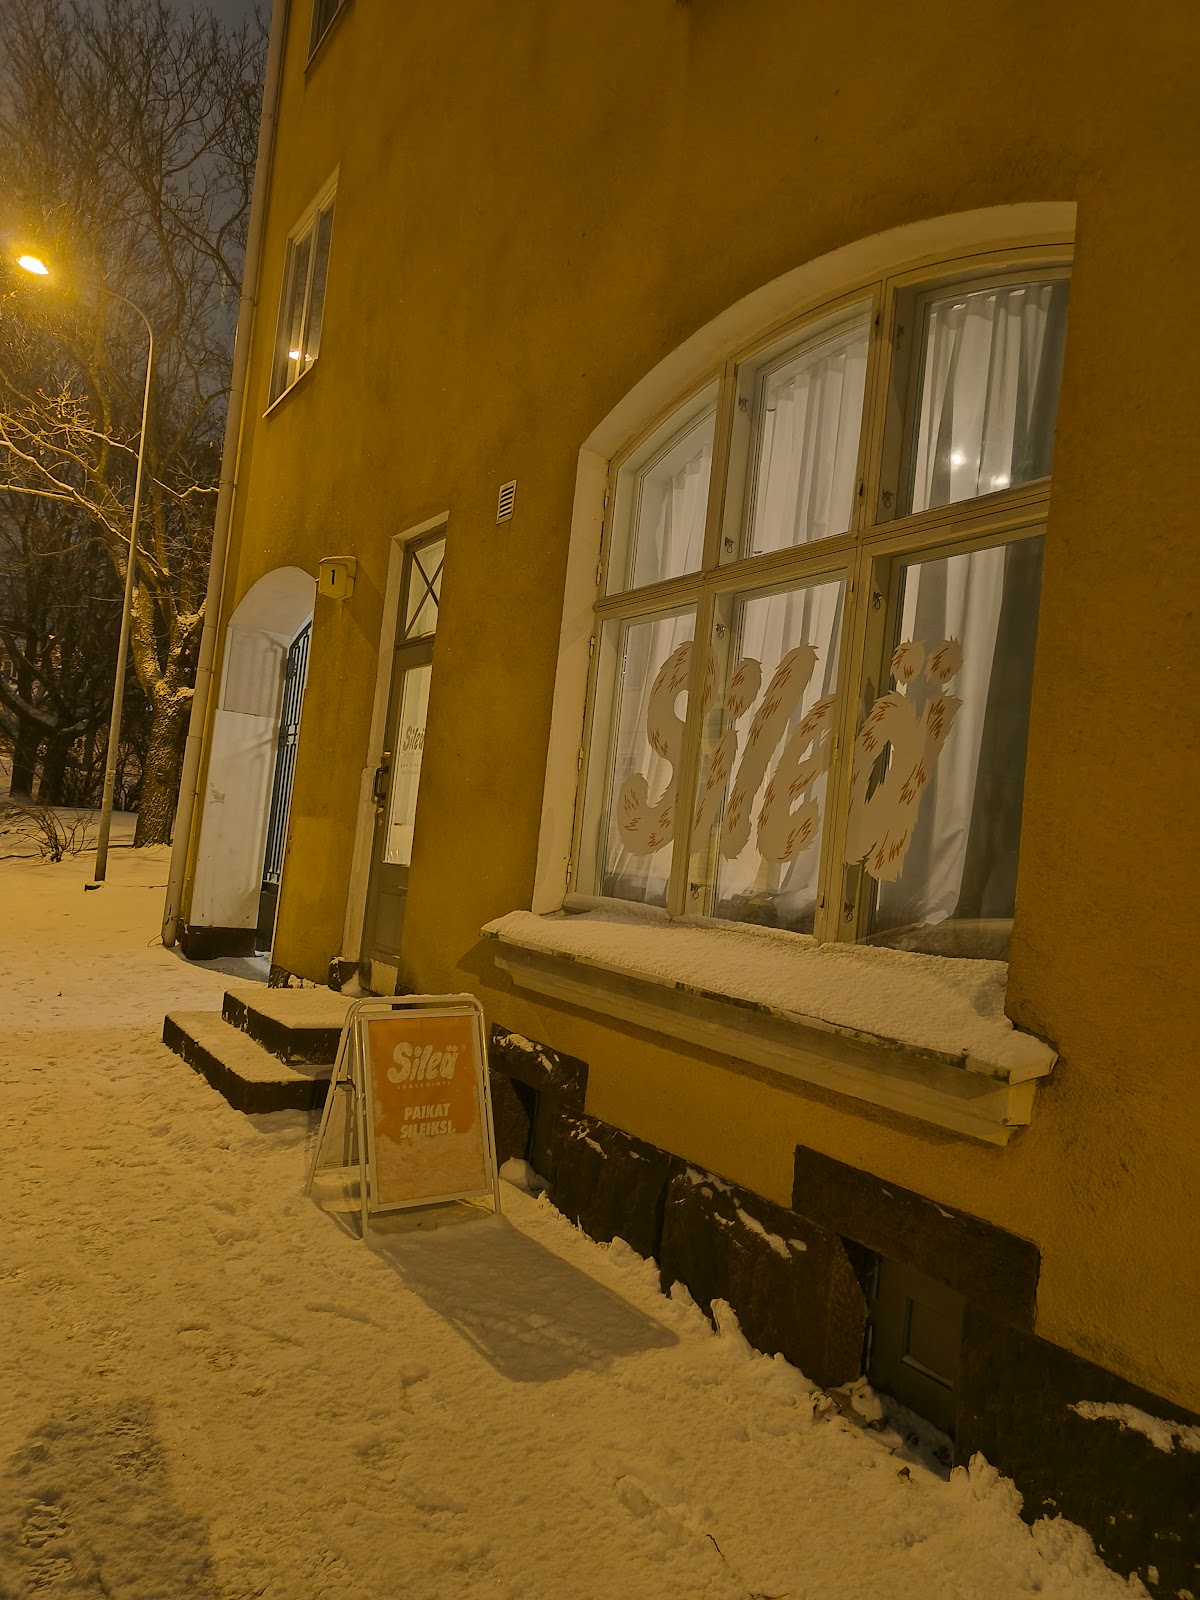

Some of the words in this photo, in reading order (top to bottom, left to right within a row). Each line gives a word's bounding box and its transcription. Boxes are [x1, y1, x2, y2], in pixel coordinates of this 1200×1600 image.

[331, 569, 336, 585] 1
[617, 636, 963, 882] Sileä
[387, 1041, 459, 1084] Sileä
[404, 1103, 451, 1120] PAIKAT
